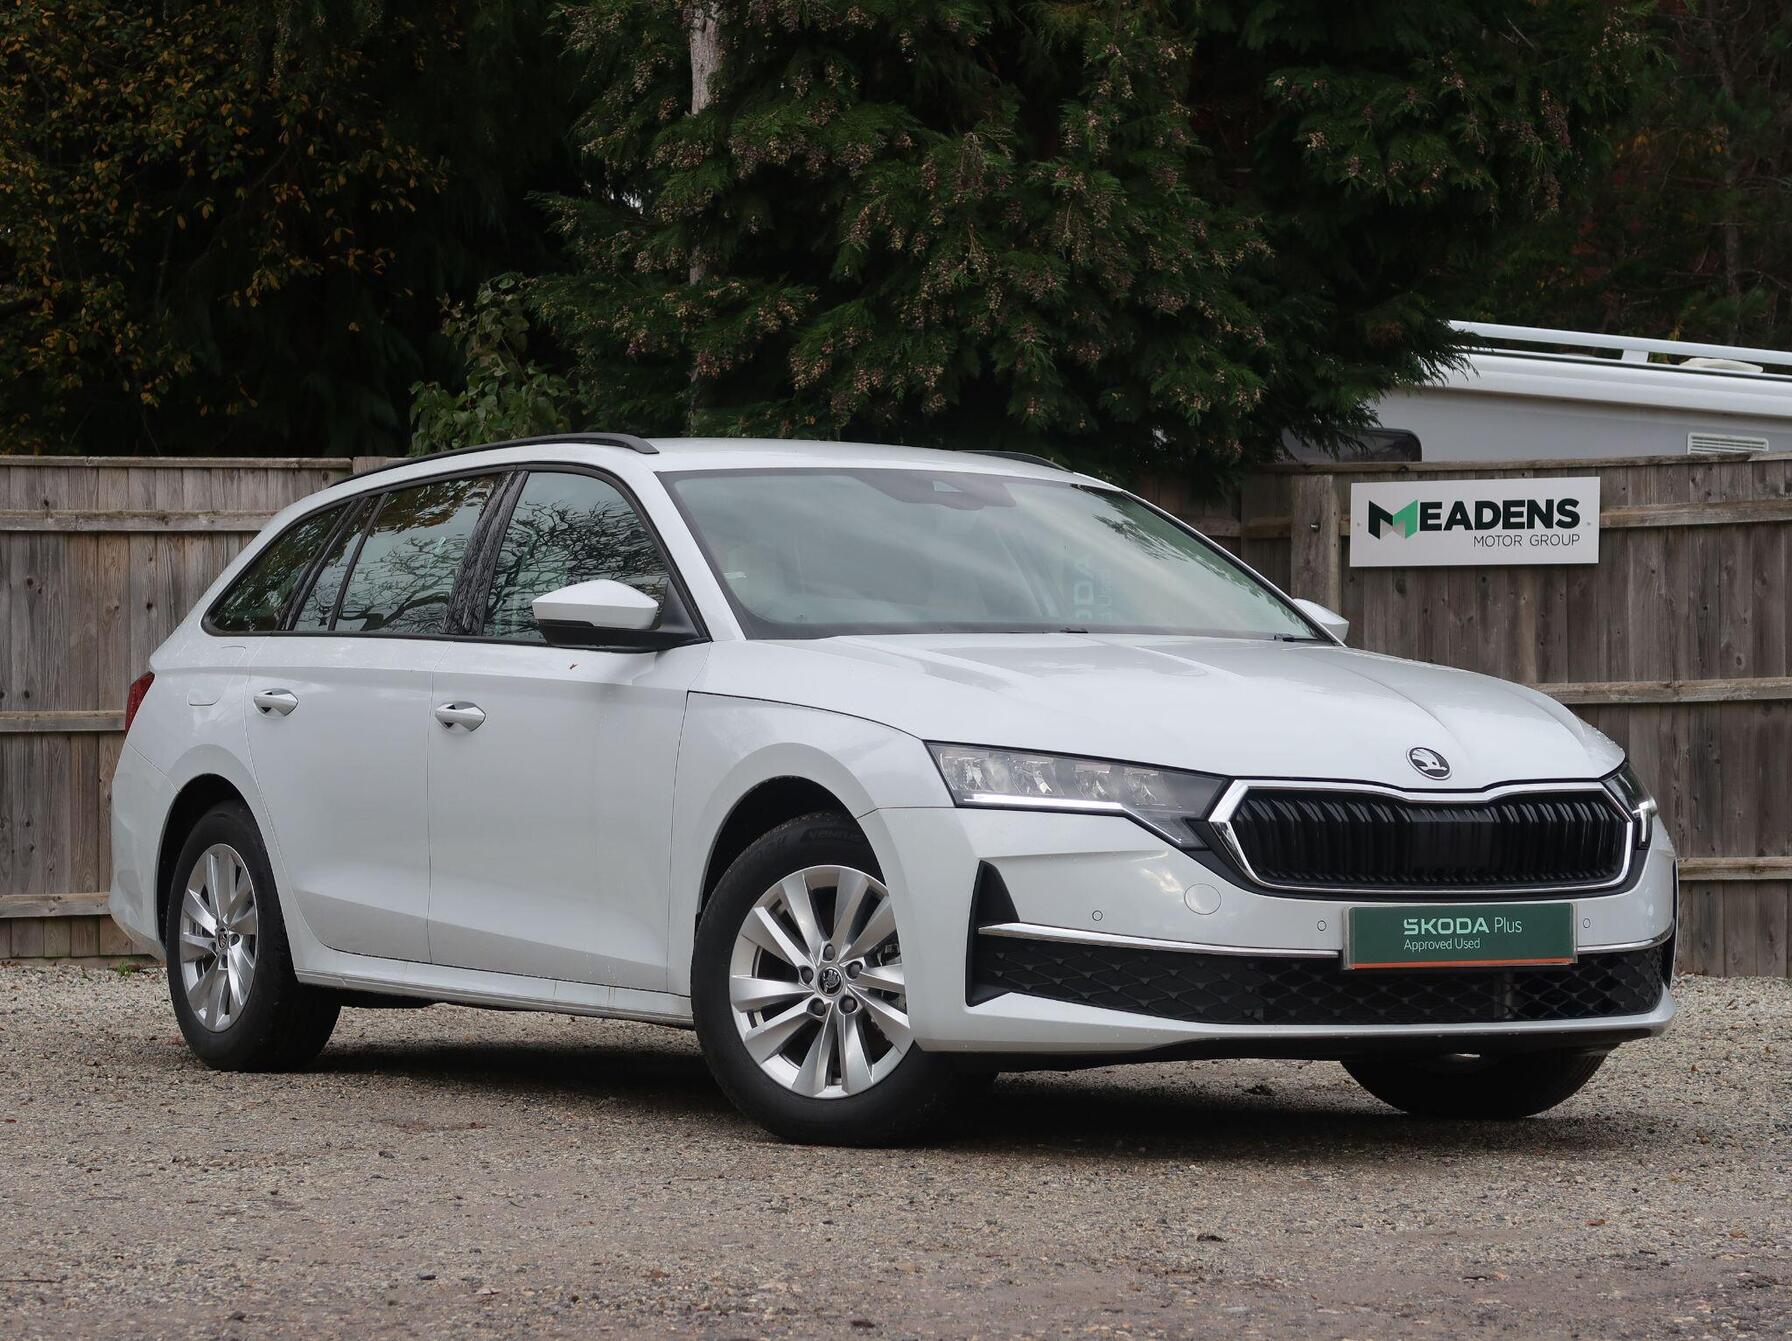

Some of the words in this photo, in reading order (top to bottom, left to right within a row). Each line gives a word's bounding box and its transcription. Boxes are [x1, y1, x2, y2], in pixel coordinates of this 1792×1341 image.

[1368, 498, 1581, 540] MEADENS
[1473, 534, 1523, 548] MOTOR
[1529, 533, 1581, 547] GROUP
[1494, 916, 1523, 933] Plus
[1403, 938, 1453, 952] Approved
[1454, 937, 1481, 950] Used
